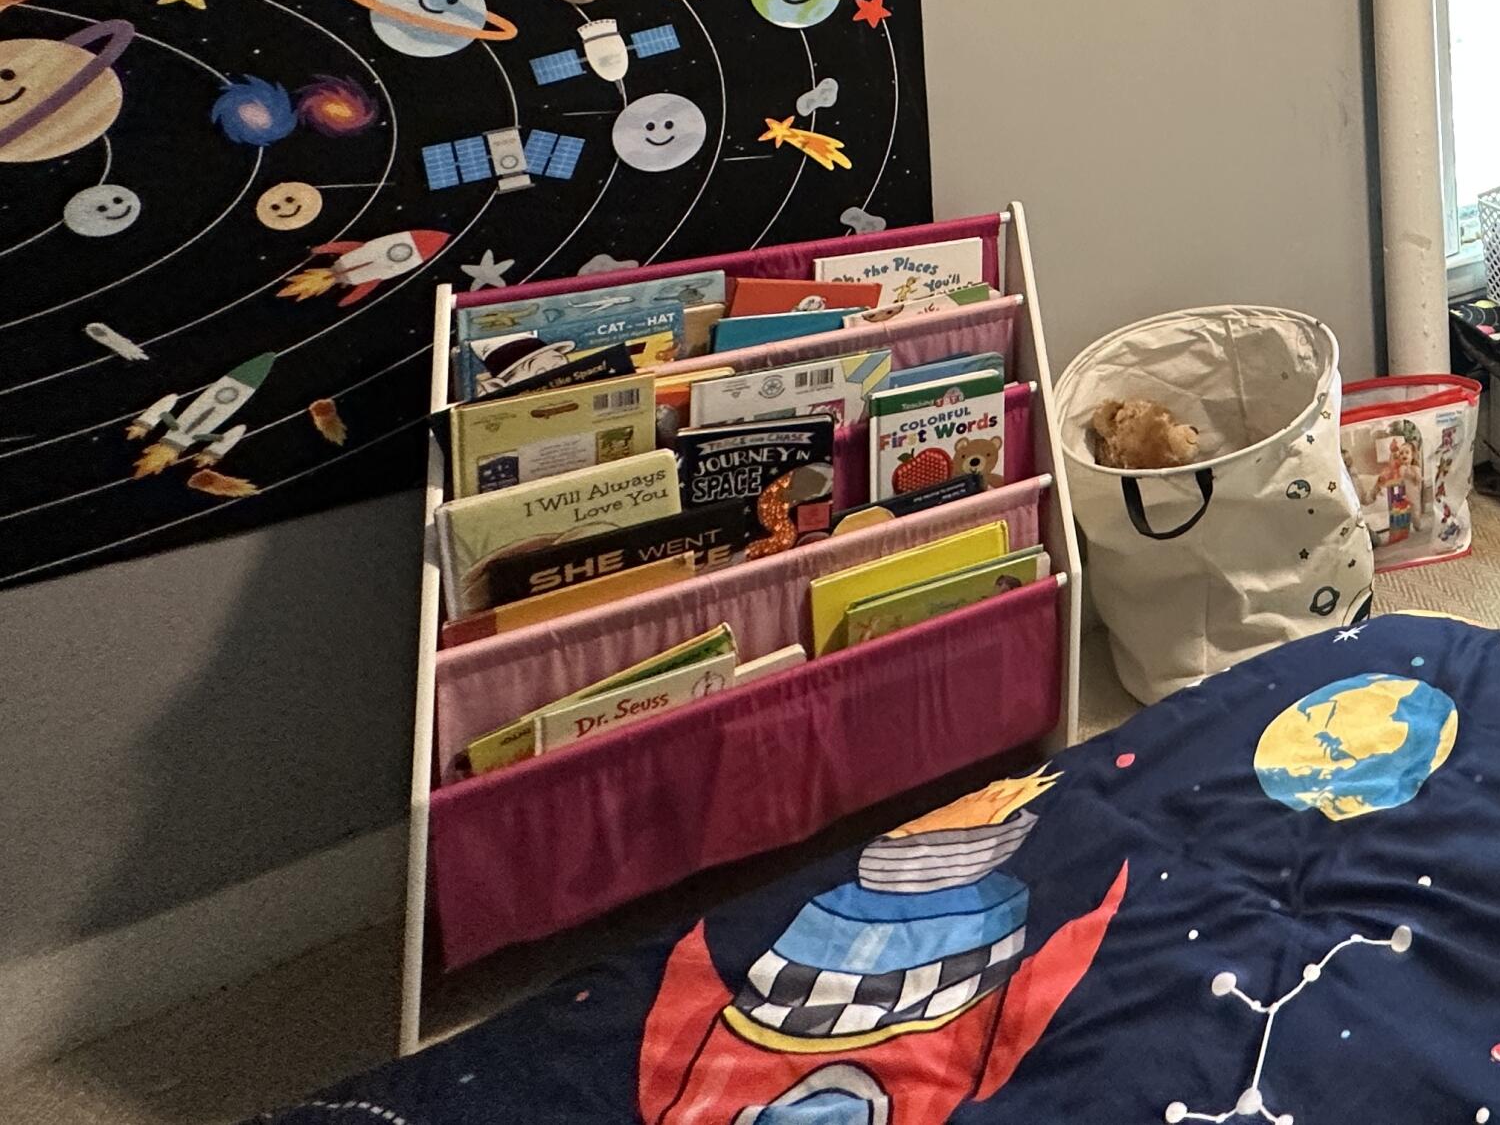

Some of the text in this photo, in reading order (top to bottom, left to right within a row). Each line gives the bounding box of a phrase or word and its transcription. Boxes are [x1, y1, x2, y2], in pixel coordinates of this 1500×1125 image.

[863, 264, 890, 278] the
[893, 256, 940, 276] Places
[923, 273, 961, 293] You'll
[597, 321, 626, 335] CAT
[647, 312, 676, 327] HAT
[879, 412, 998, 452] First Words
[900, 407, 971, 432] COLORFUL
[767, 432, 805, 443] CHASE
[693, 446, 811, 477] JOURNEY IN
[523, 468, 667, 519] I Will Always
[692, 465, 764, 503] SPACE
[573, 486, 670, 524] Love You
[528, 547, 625, 594] SHE
[637, 527, 723, 563] WENT
[573, 691, 670, 739] Dr. Seuss
